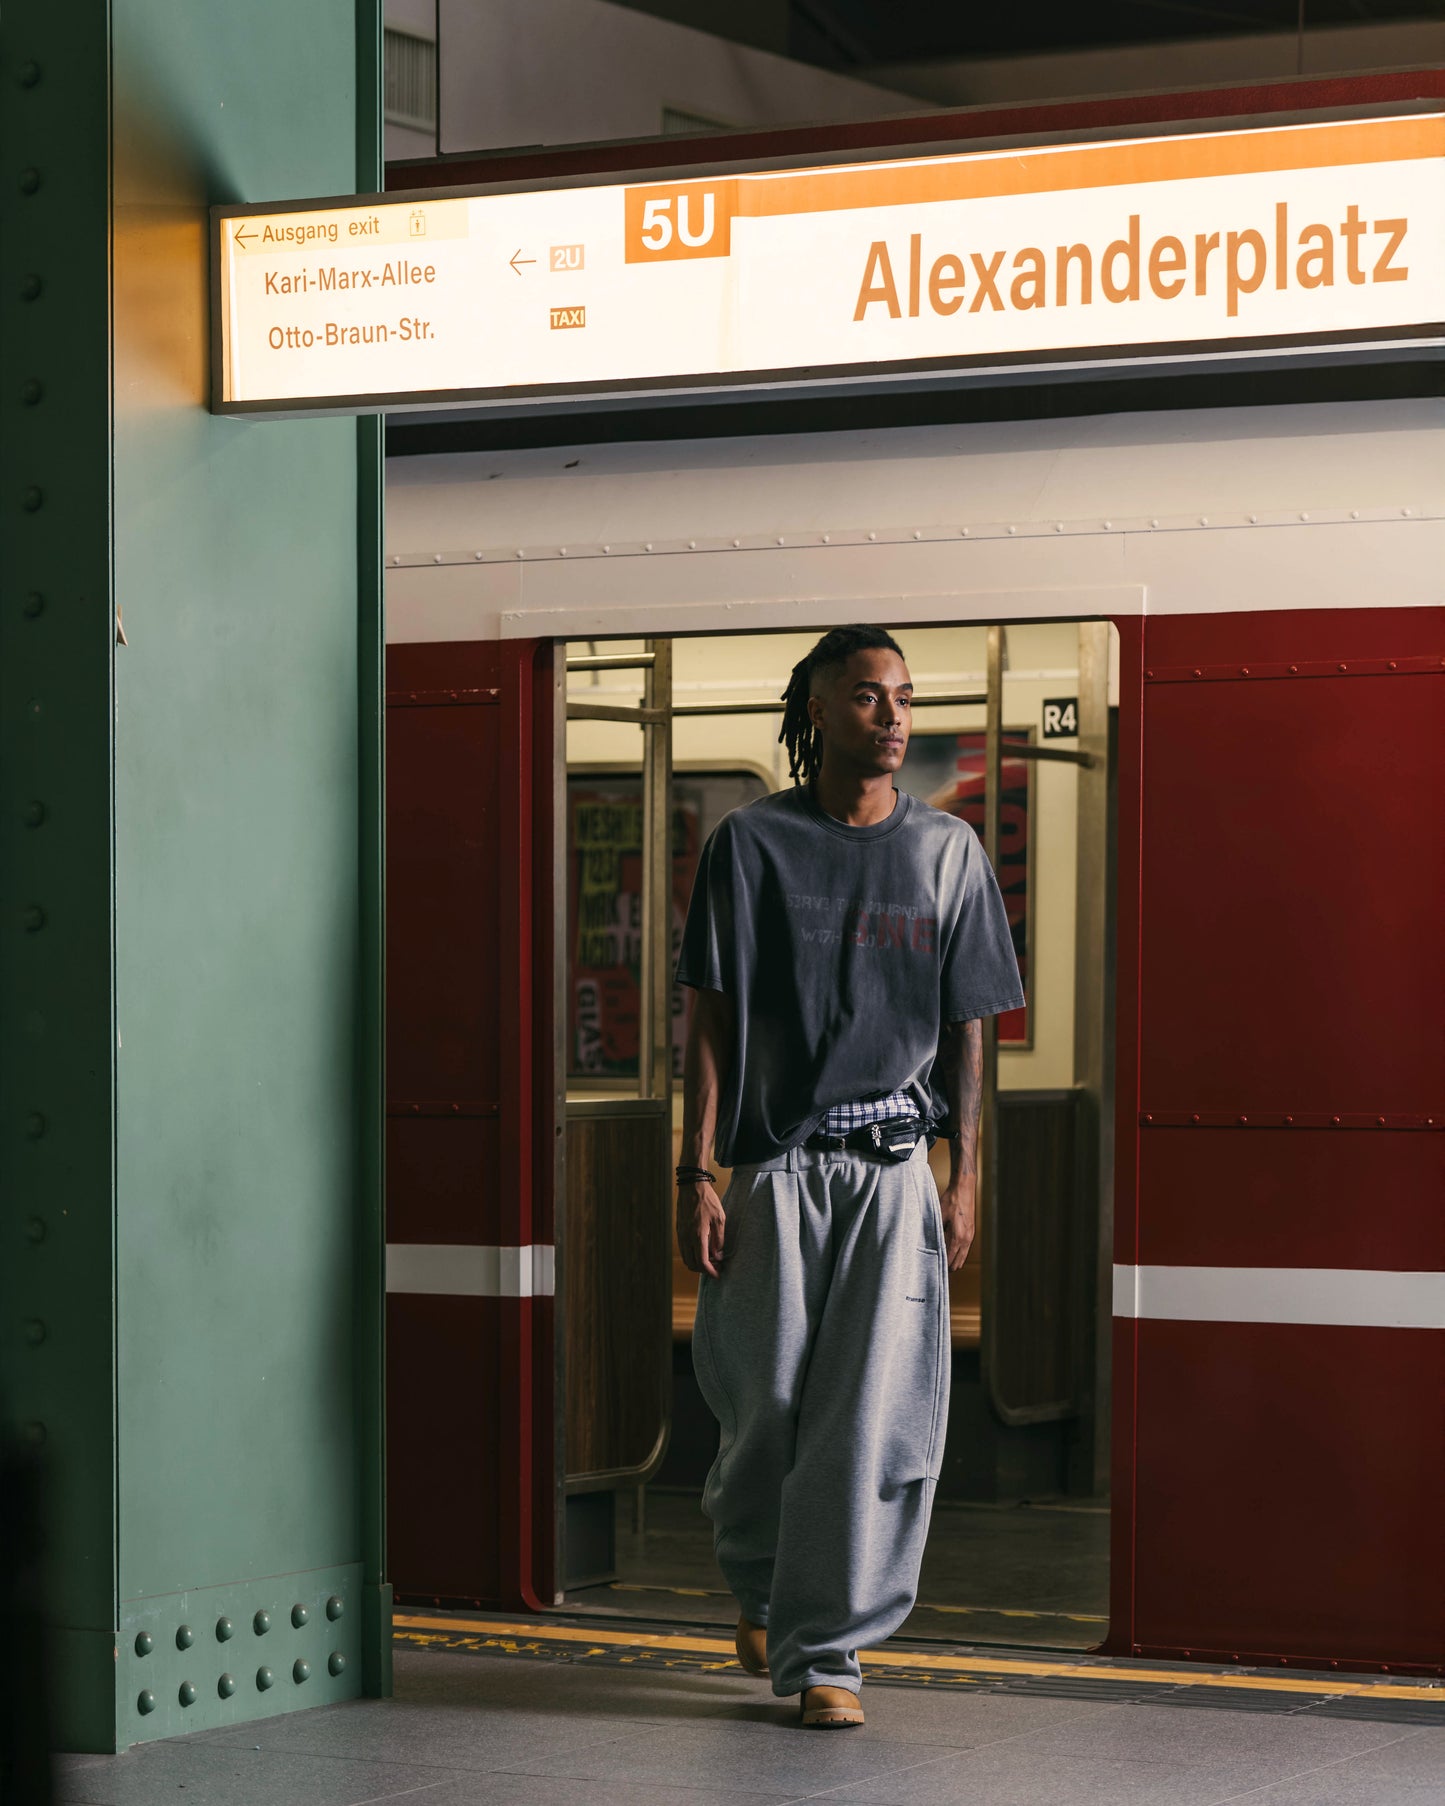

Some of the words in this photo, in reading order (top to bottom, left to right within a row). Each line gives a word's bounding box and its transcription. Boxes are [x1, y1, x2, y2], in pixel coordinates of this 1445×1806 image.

[262, 223, 338, 245] Ausgang
[349, 215, 380, 236] exit
[641, 192, 715, 251] 5U
[553, 247, 581, 269] 2U
[853, 202, 1408, 322] Alexanderplatz
[265, 260, 436, 295] Kari-Marx-Allee
[269, 317, 435, 350] Otto-Braun-Str.
[550, 309, 585, 327] TAXI
[1044, 703, 1077, 733] R4
